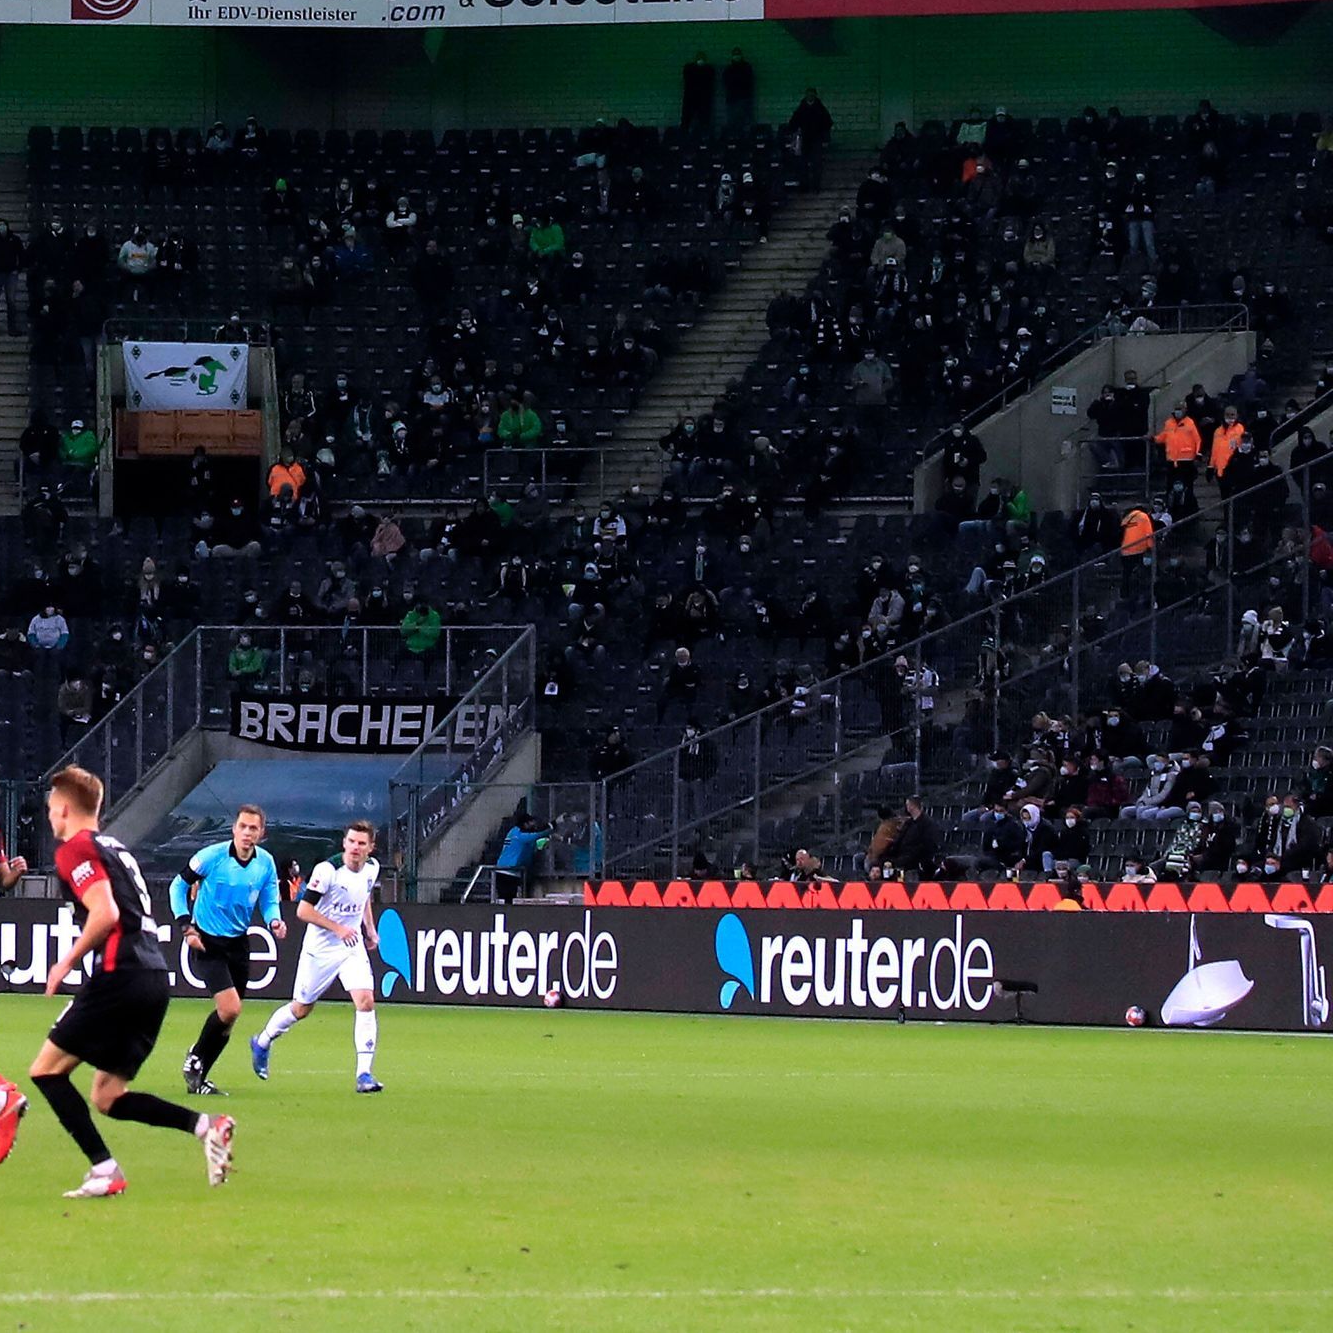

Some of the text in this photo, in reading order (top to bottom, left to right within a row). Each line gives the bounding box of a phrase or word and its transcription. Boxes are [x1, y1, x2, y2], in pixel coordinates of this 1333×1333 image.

[187, 6, 358, 22] Ihr EDV-Dienstleister
[382, 4, 445, 22] .com
[415, 909, 619, 1000] reuter.de
[760, 914, 994, 1011] reuter.de
